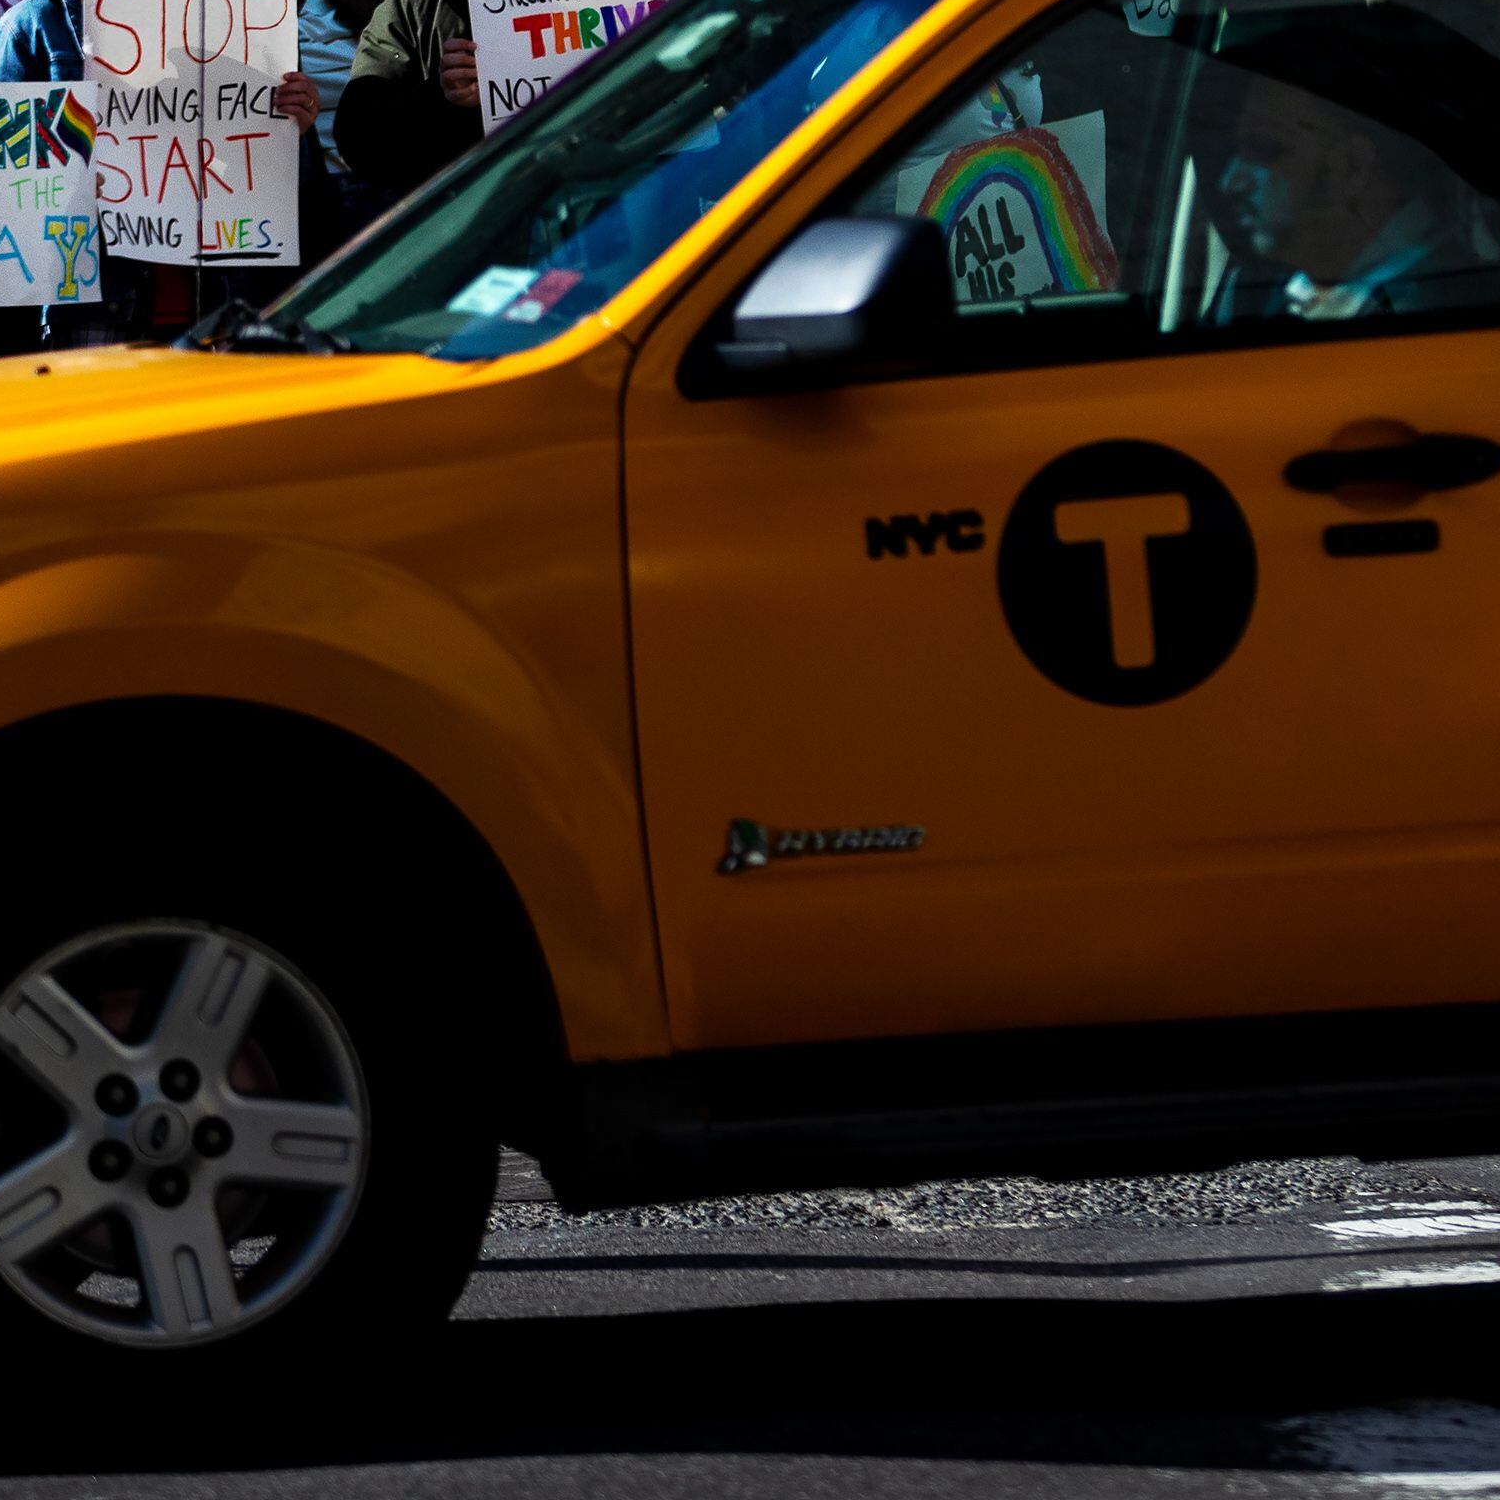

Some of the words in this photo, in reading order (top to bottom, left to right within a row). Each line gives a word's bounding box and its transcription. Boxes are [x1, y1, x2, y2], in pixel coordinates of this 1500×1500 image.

[9, 175, 65, 210] THE
[97, 132, 270, 204] START
[101, 211, 183, 248] SAVING
[955, 197, 1025, 278] ALL
[865, 511, 984, 560] NYC
[1051, 490, 1193, 672] T
